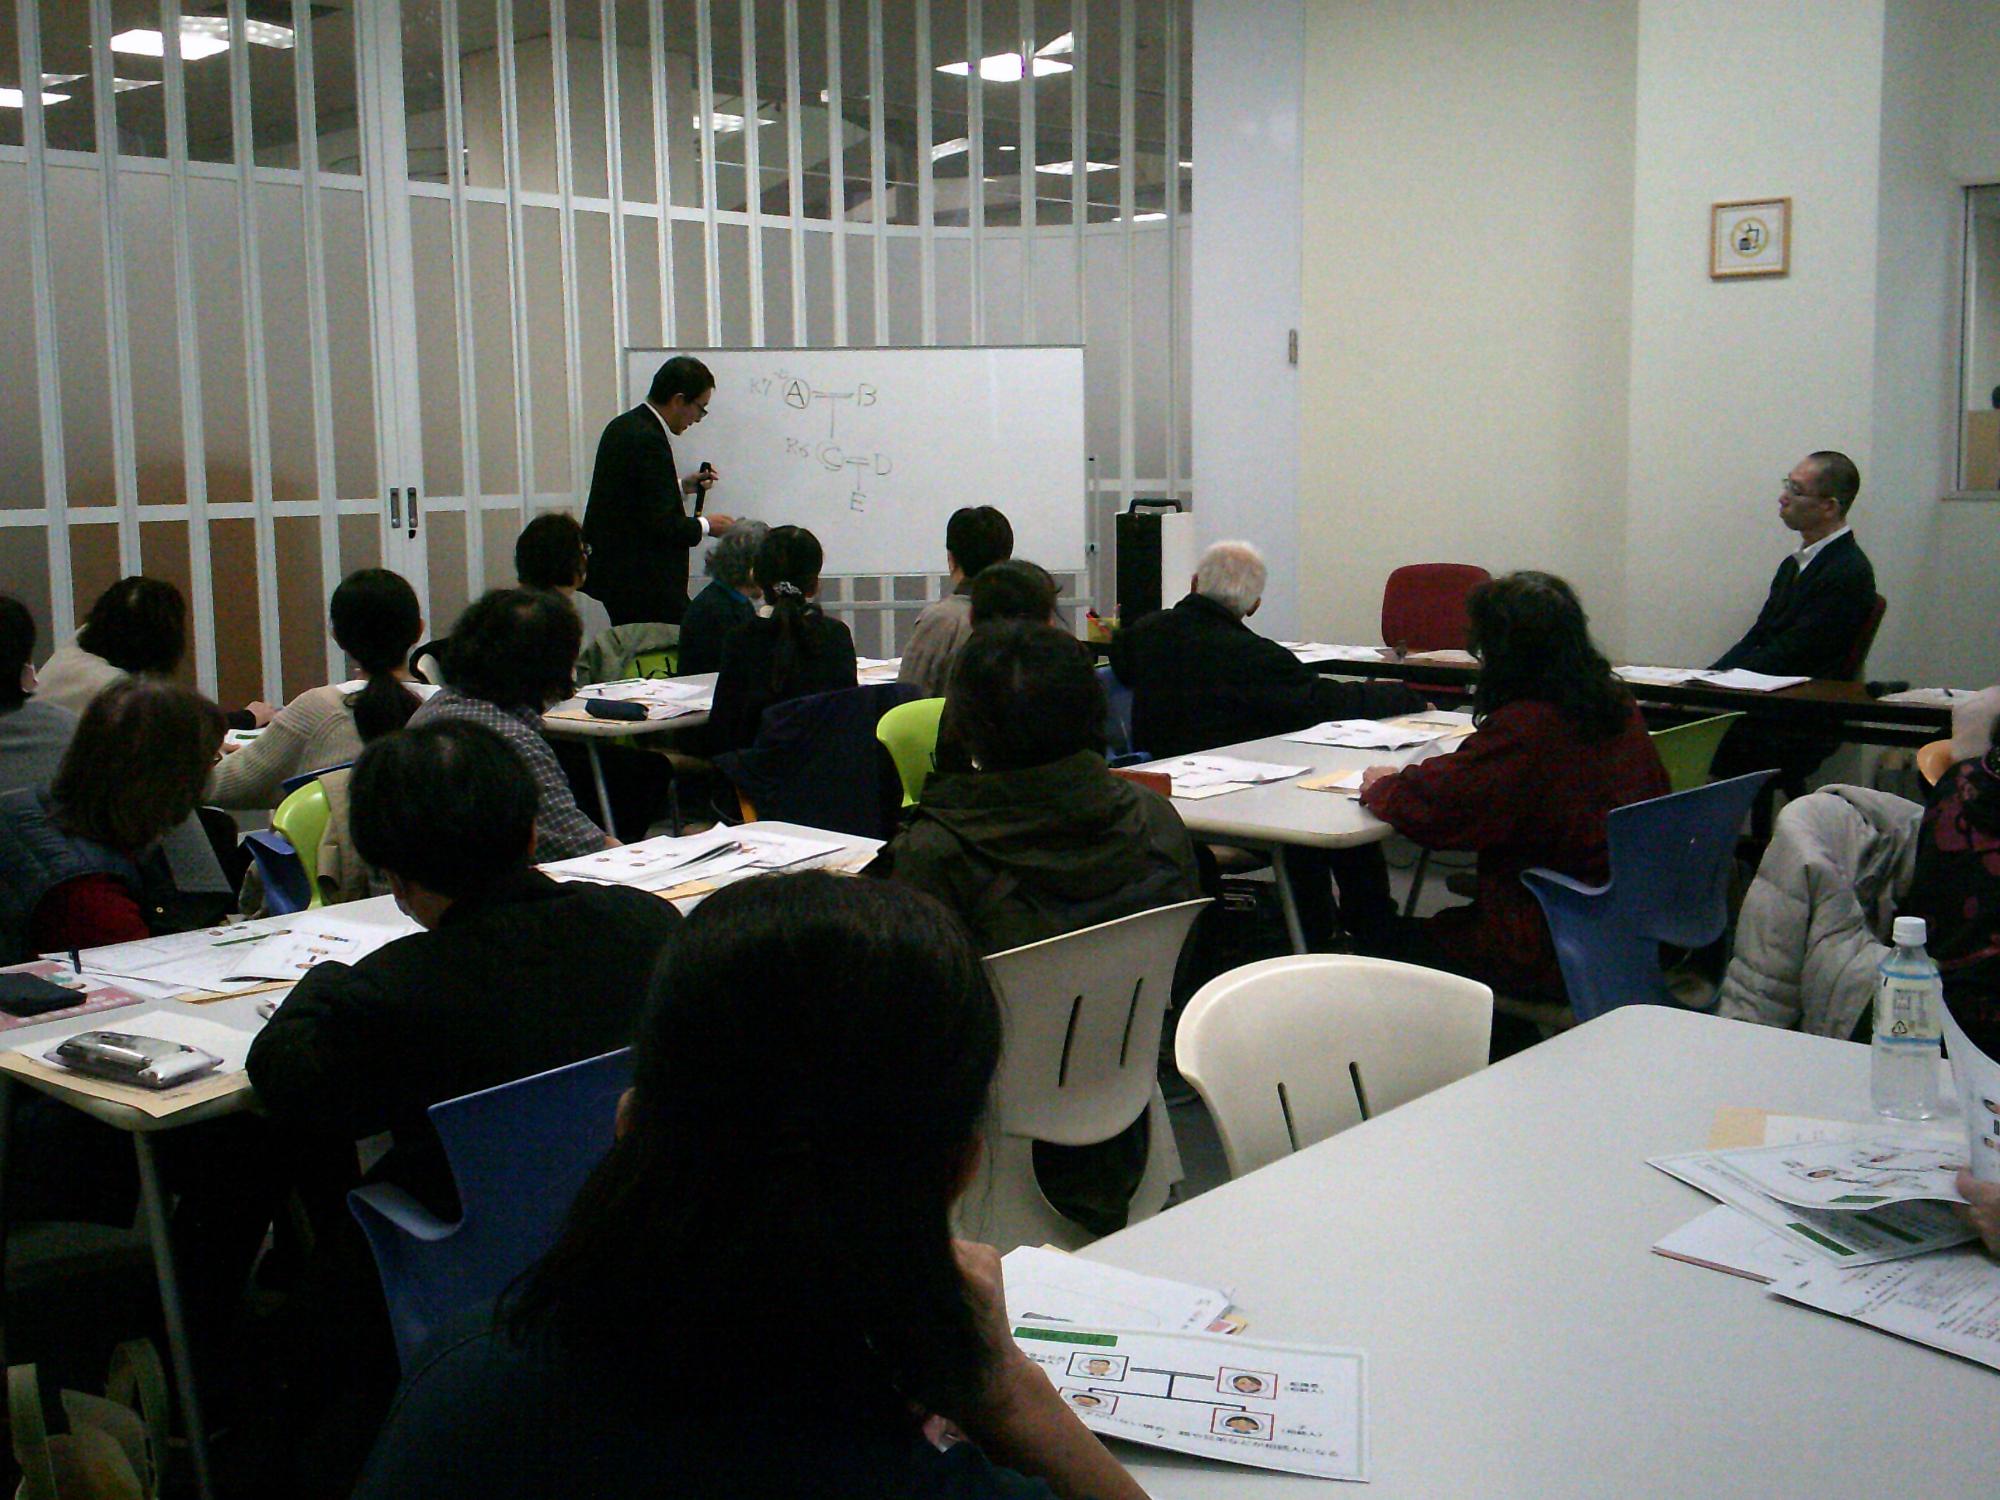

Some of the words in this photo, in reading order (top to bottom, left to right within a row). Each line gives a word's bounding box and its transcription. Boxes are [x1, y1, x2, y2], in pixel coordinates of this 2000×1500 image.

[787, 379, 805, 406] A
[857, 383, 877, 406] B
[874, 453, 892, 475] D
[850, 491, 866, 512] E
